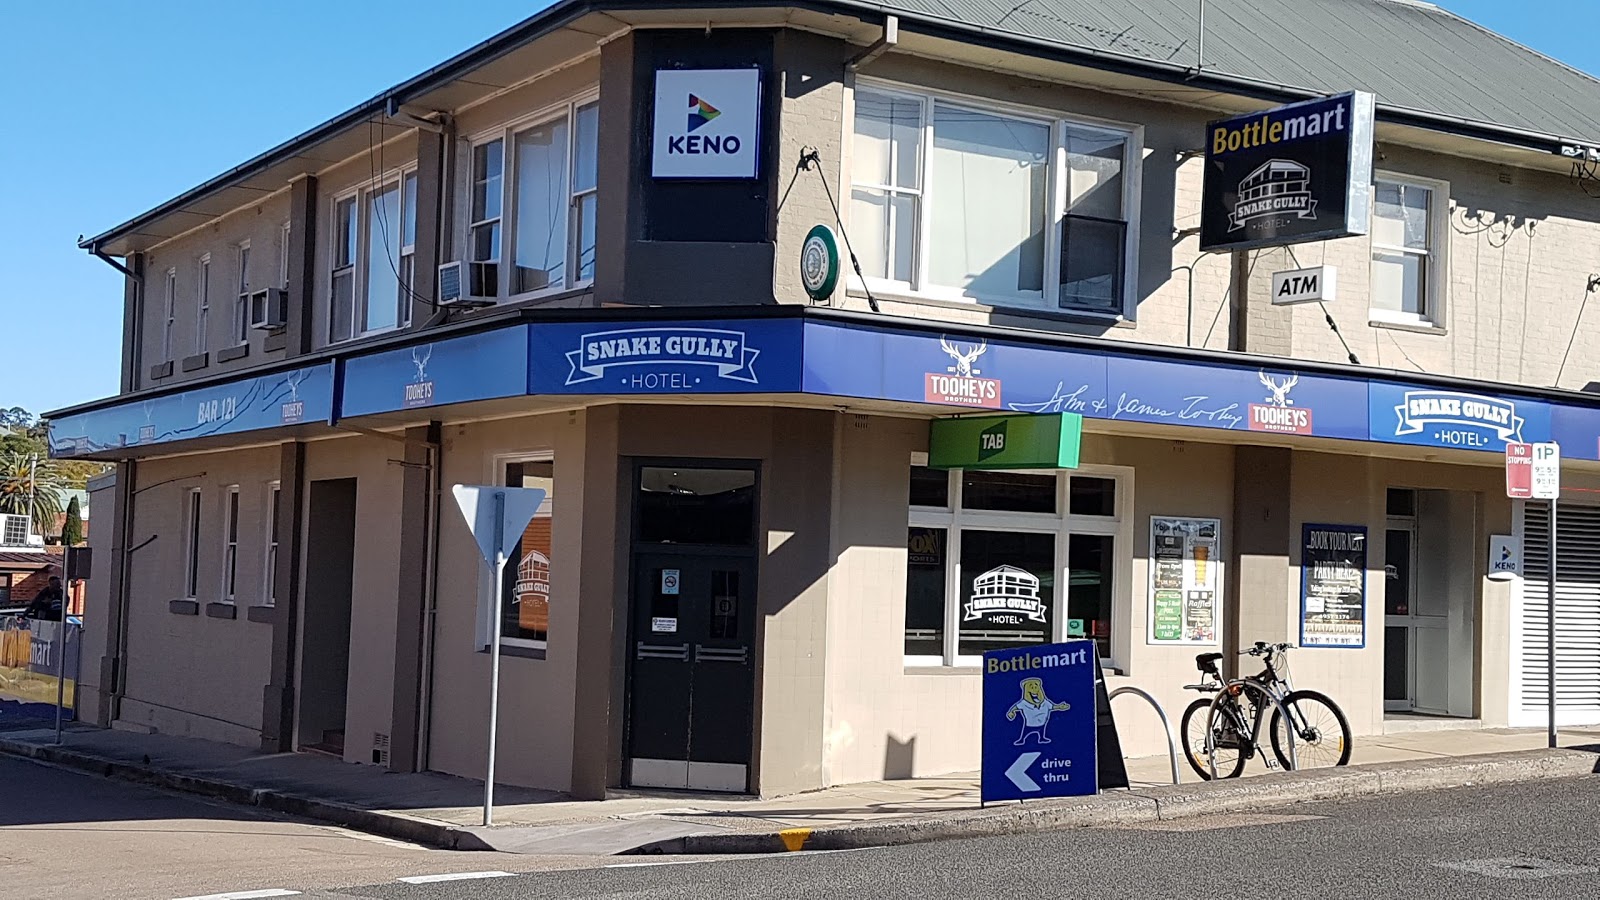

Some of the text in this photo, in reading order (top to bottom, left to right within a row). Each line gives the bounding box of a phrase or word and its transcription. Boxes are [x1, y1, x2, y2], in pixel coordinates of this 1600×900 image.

[1213, 103, 1345, 154] Bottlemart
[668, 135, 741, 154] KENO
[1237, 196, 1308, 217] SNAKE GULLY
[1256, 219, 1286, 231] HOTEL
[1278, 275, 1317, 296] ATM
[587, 336, 738, 360] SNAKE GULLY
[631, 373, 692, 389] HOTEL
[931, 376, 996, 399] TOOHEYS
[405, 382, 432, 400] TOOHEYS
[945, 396, 982, 404] BROTHERS
[1111, 392, 1175, 420] James
[197, 396, 236, 423] BAR 121
[282, 402, 303, 417] TOOHEYS
[1252, 406, 1308, 427] TOOHEYS
[1410, 399, 1510, 425] SNAKE GULLY
[1265, 424, 1296, 432] BROTHERS
[981, 433, 1004, 450] TAB
[1441, 430, 1483, 447] HOTEL
[1514, 446, 1525, 455] NO
[1537, 445, 1554, 460] 1P
[1508, 457, 1532, 465] STOPPING
[1310, 531, 1363, 552] BOOK YOUR NEXT
[1314, 561, 1335, 579] PARTY
[1495, 561, 1515, 570] KENO
[974, 598, 1038, 611] SNAKE GULLY
[993, 615, 1019, 624] HOTEL
[987, 648, 1087, 674] Bottlemart
[1041, 758, 1072, 769] drive
[1043, 773, 1069, 783] thru
